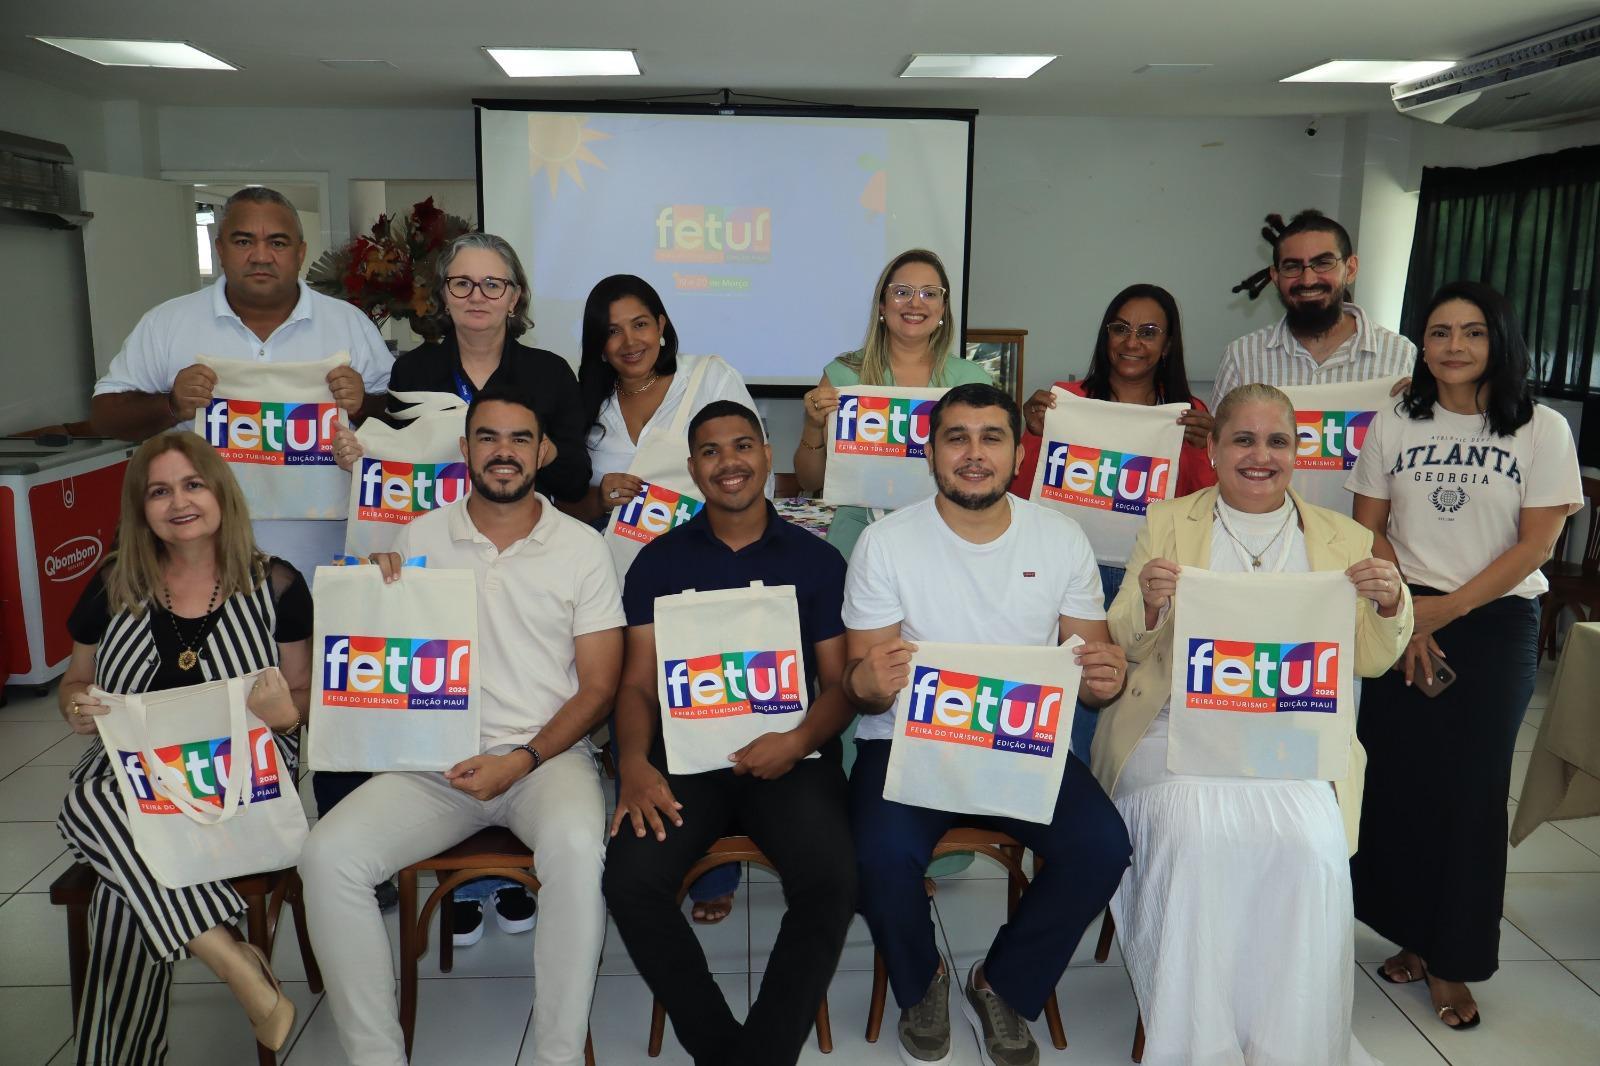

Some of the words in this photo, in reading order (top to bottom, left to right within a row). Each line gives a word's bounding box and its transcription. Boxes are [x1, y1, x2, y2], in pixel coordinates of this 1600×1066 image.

[656, 207, 769, 250] fetur
[207, 402, 337, 451] fetur
[839, 398, 931, 444] fetu
[245, 453, 277, 461] TURISMO
[288, 454, 314, 463] EDIÇÃO
[1048, 445, 1168, 500] fetur
[1390, 443, 1521, 484] ATLANTA
[363, 462, 464, 509] fetu
[1414, 471, 1489, 484] GEORGIA
[1045, 489, 1063, 498] FEIRA
[1076, 496, 1106, 506] TURISMO
[1115, 502, 1140, 513] EDIÇÃO
[45, 545, 96, 577] Qbombom
[326, 638, 469, 693] fetur
[668, 654, 795, 707] fetur
[1190, 642, 1337, 697] fetur
[363, 697, 399, 705] TURISMO
[412, 696, 440, 706] EDIÇÃO
[443, 697, 465, 706] PIAUÍ
[710, 705, 744, 715] TURISMO
[754, 704, 778, 712] EDIÇÃO
[780, 703, 799, 711] PIAUÍ
[914, 671, 1061, 736] fetur
[1232, 700, 1268, 709] TURISMO
[1279, 699, 1307, 709] EDIÇÃO
[1310, 700, 1333, 708] PIAUÍ
[910, 726, 933, 735] FEIRA
[935, 729, 947, 737] DO
[949, 731, 985, 743] TURISMO
[996, 739, 1026, 749] EDIÇÃO
[1028, 743, 1050, 753] PIAUÍ
[1034, 731, 1054, 741] 2026
[259, 774, 278, 784] 2026
